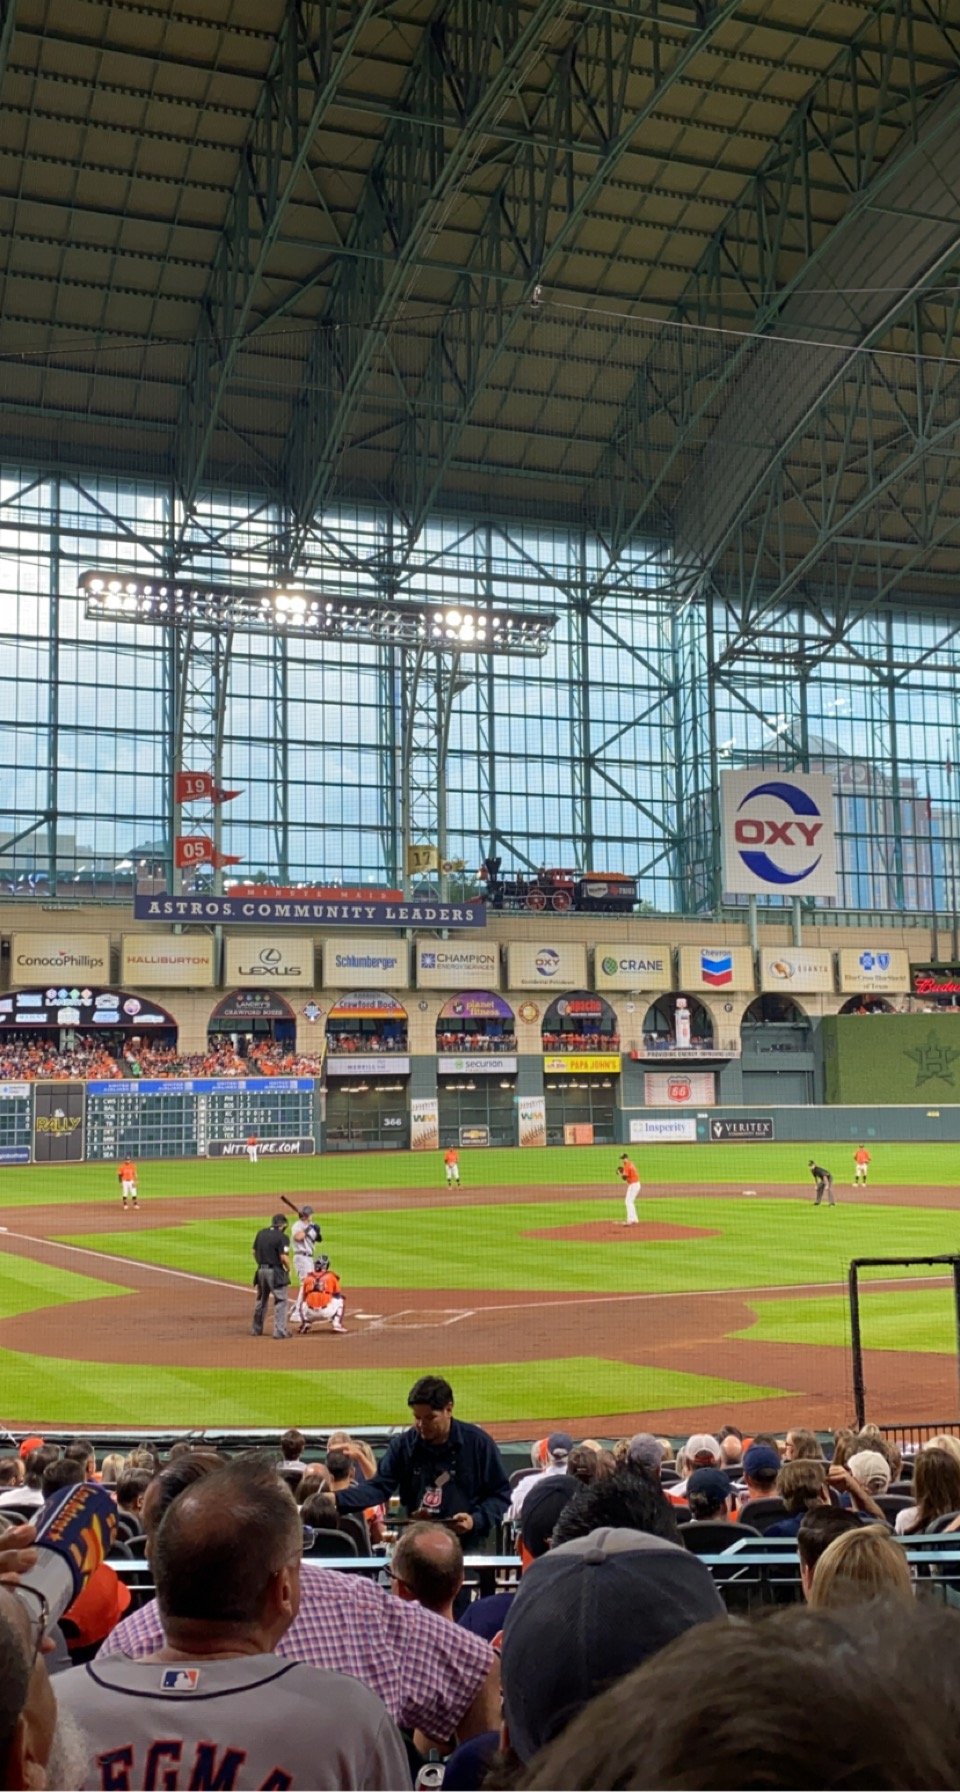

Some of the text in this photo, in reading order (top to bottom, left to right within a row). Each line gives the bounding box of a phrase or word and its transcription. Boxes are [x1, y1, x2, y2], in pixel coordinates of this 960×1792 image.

[185, 779, 205, 794] 19
[735, 819, 824, 846] OXY
[183, 842, 205, 859] 05
[412, 850, 431, 867] 17
[341, 891, 388, 900] MAID
[242, 904, 377, 919] COMMUNITY
[385, 907, 475, 921] LEADERS
[437, 953, 495, 964] CHAMPION
[701, 949, 732, 957] Chevron
[17, 954, 104, 969] ConocoPhillips
[127, 955, 209, 965] HALLIBURTON
[335, 955, 397, 970] Schlumberger
[535, 957, 560, 967] OXY
[619, 959, 663, 971] CRANE
[238, 966, 302, 976] LEXUS
[466, 999, 494, 1010] planet
[470, 1008, 500, 1016] fitness
[465, 1060, 503, 1068] securian
[570, 1060, 589, 1070] PAPA
[671, 1086, 687, 1096] 66
[36, 1116, 82, 1132] RALLY
[645, 1122, 685, 1134] Insperity
[725, 1122, 769, 1132] VERITEX
